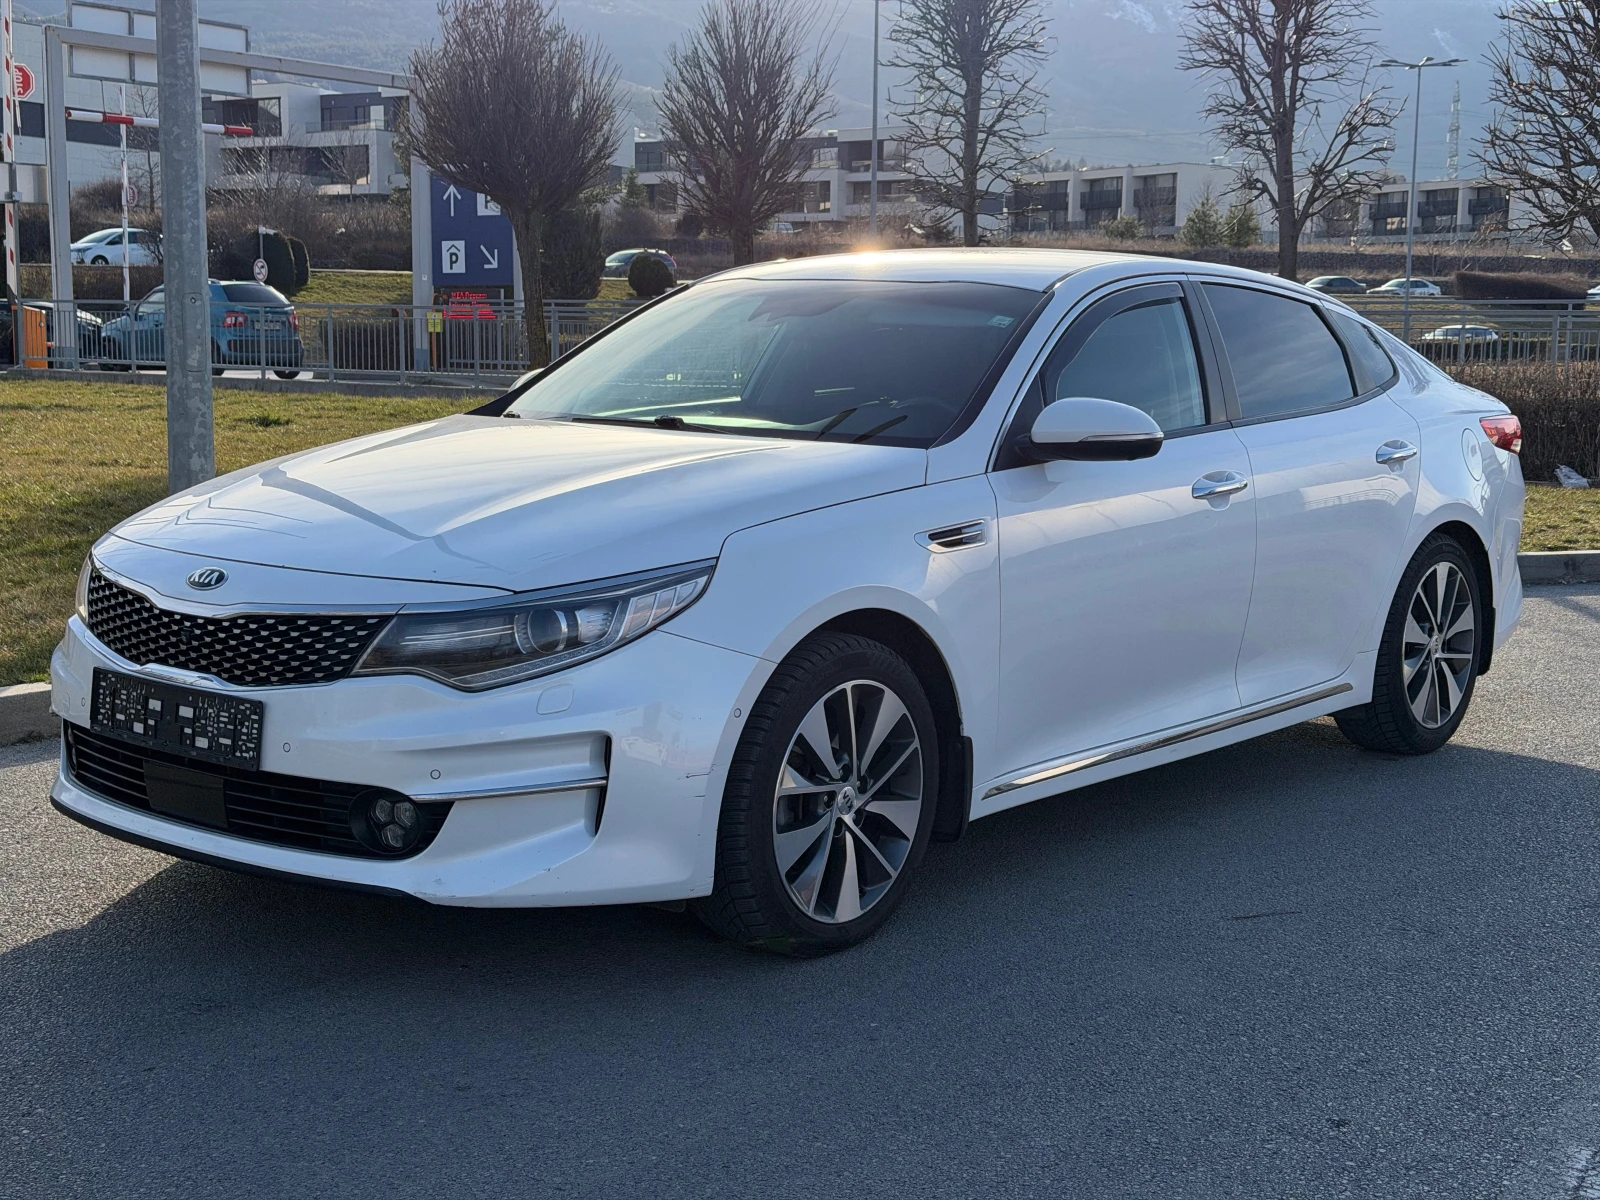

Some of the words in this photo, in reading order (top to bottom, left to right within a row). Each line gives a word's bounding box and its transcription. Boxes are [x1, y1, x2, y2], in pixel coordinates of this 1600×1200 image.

[14, 68, 24, 94] STOP
[449, 252, 459, 270] P
[190, 569, 220, 585] KIA
[842, 790, 854, 811] KIA
